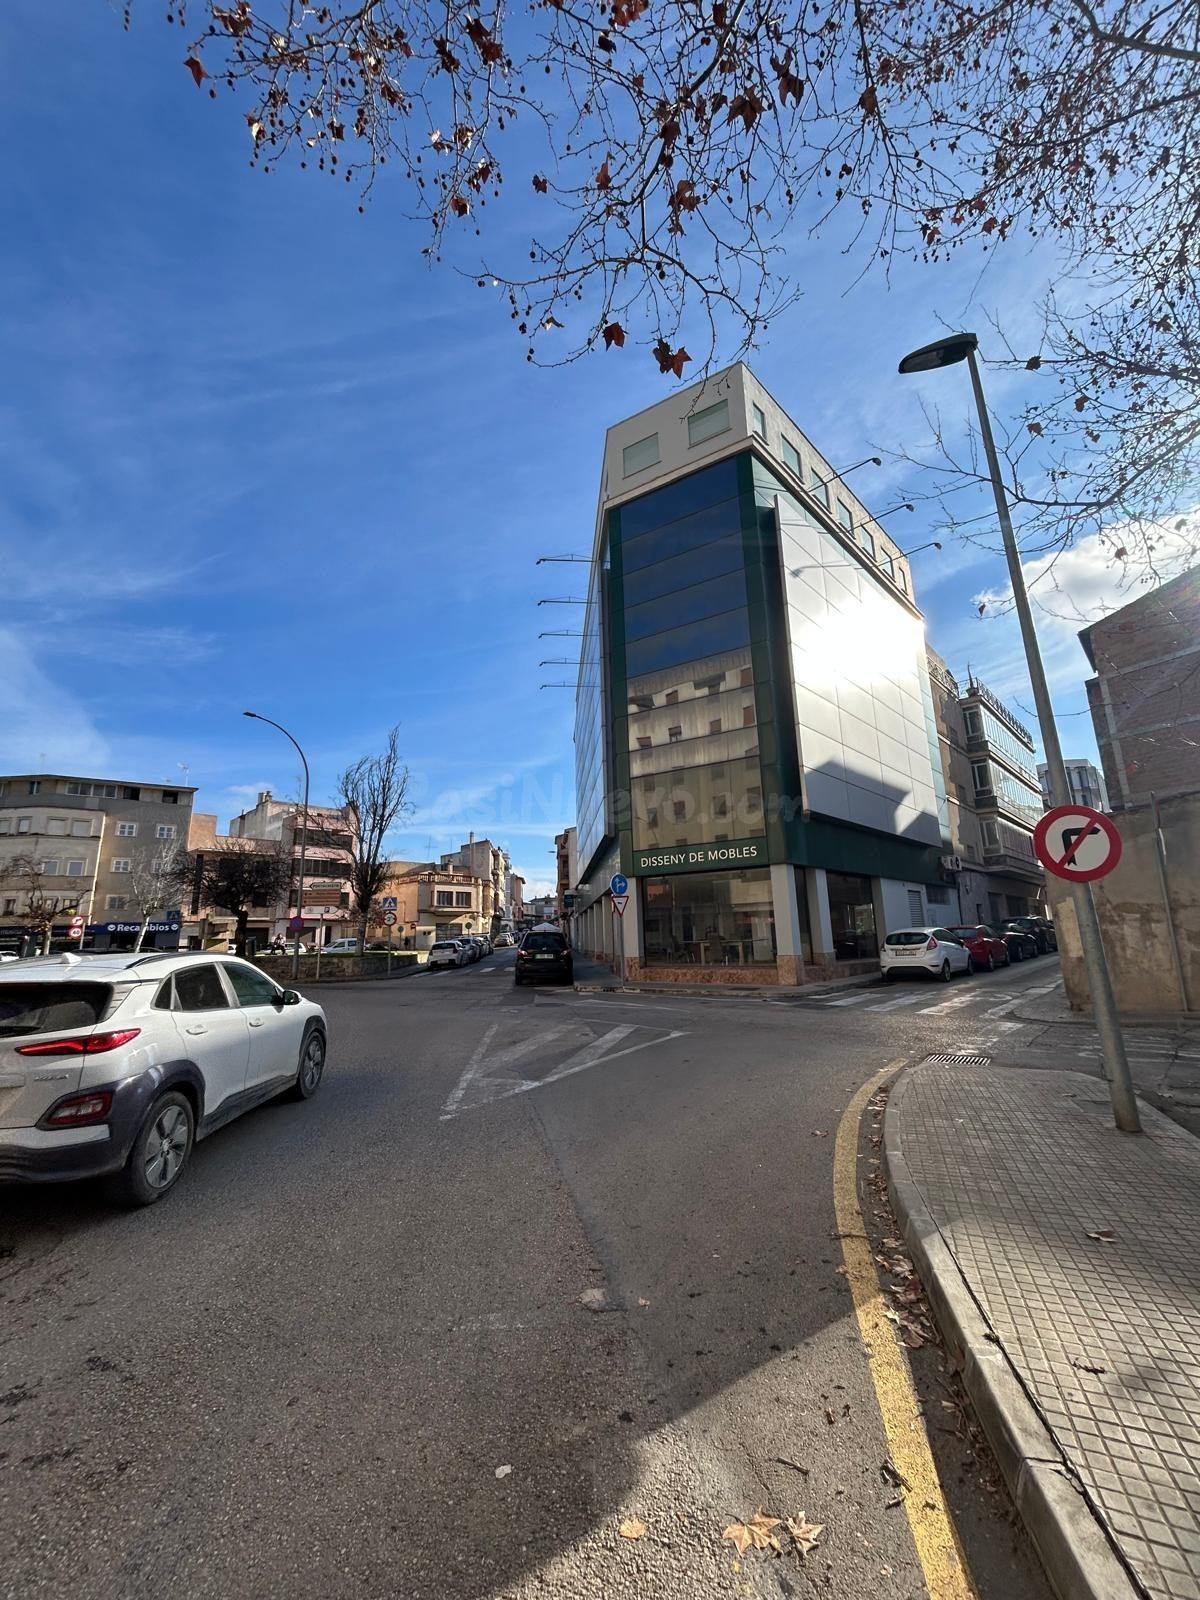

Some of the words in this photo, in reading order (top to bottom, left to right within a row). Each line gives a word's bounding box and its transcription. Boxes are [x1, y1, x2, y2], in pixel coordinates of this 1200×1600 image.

[640, 853, 686, 868] DISSENY
[689, 851, 705, 863] DE
[708, 846, 757, 861] MOBLES
